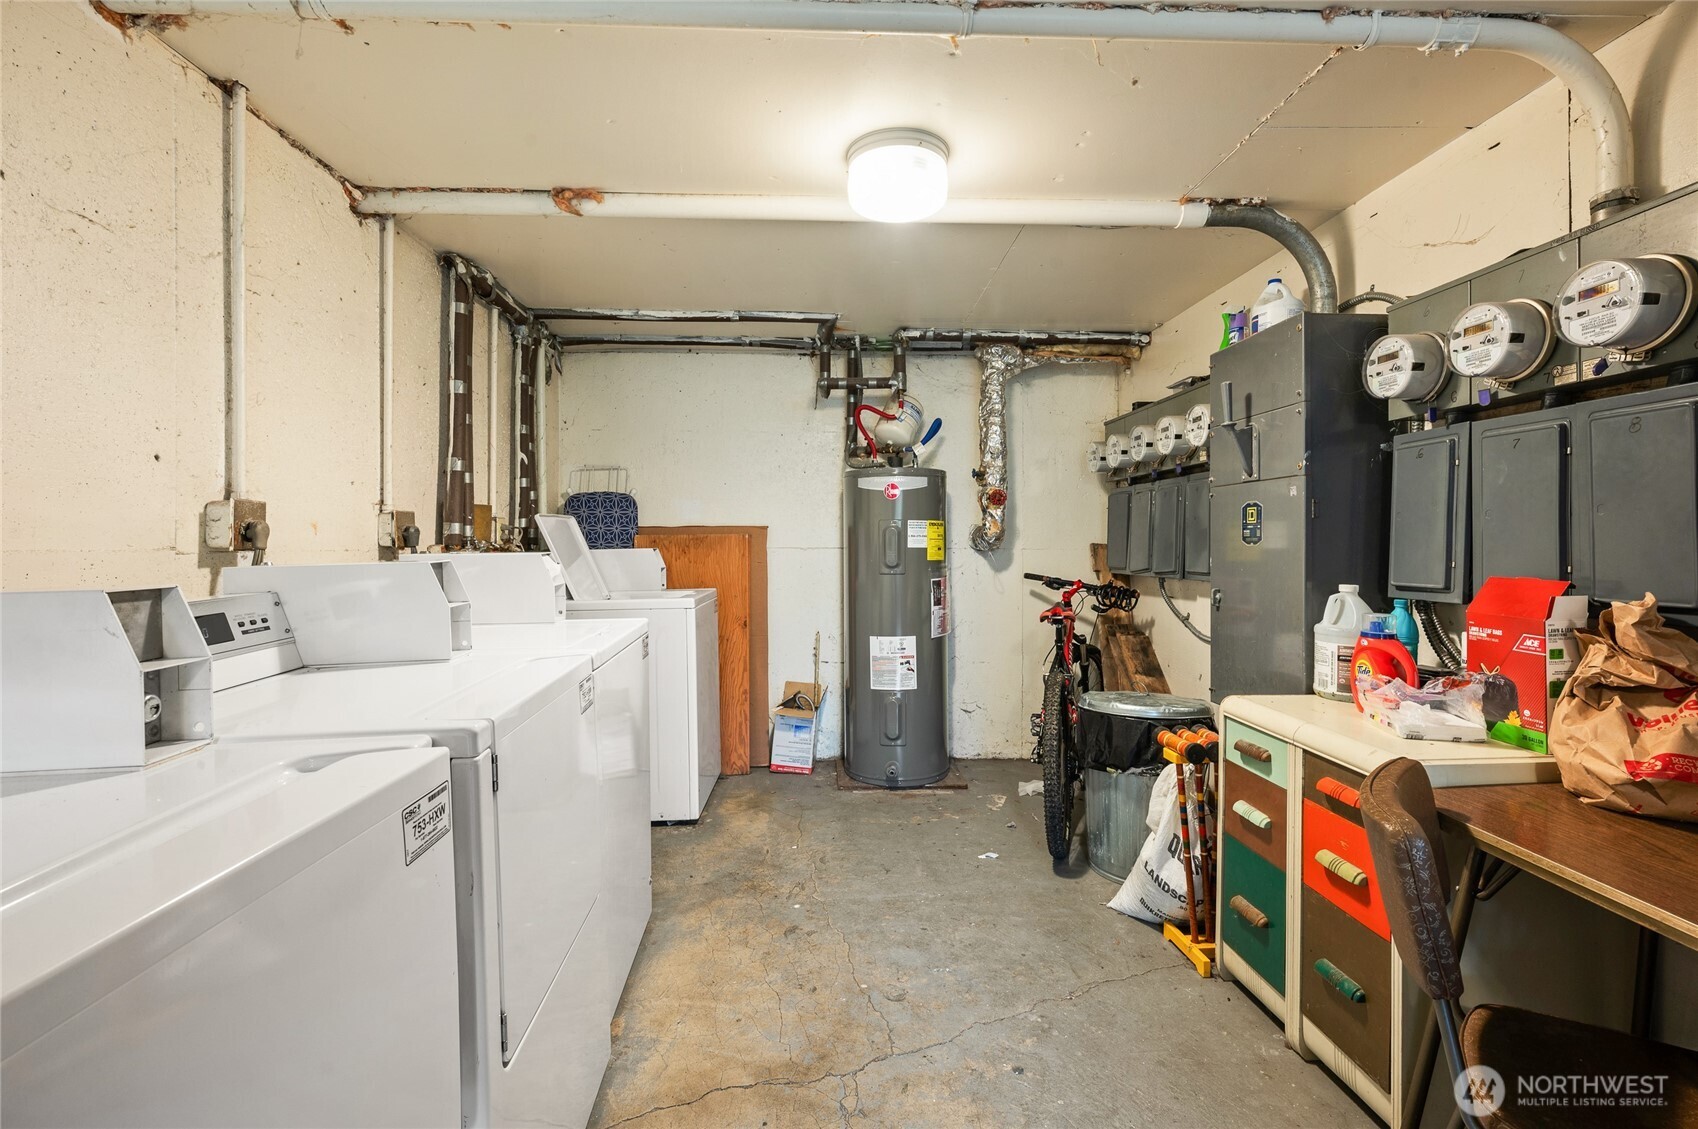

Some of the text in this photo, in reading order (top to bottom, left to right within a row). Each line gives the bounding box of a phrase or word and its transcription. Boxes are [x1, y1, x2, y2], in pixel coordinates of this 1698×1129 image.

[1629, 416, 1642, 434] 8
[1513, 438, 1521, 449] 7
[1523, 638, 1540, 648] ACE
[1357, 665, 1371, 677] Tide
[412, 803, 446, 838] 753-HXW
